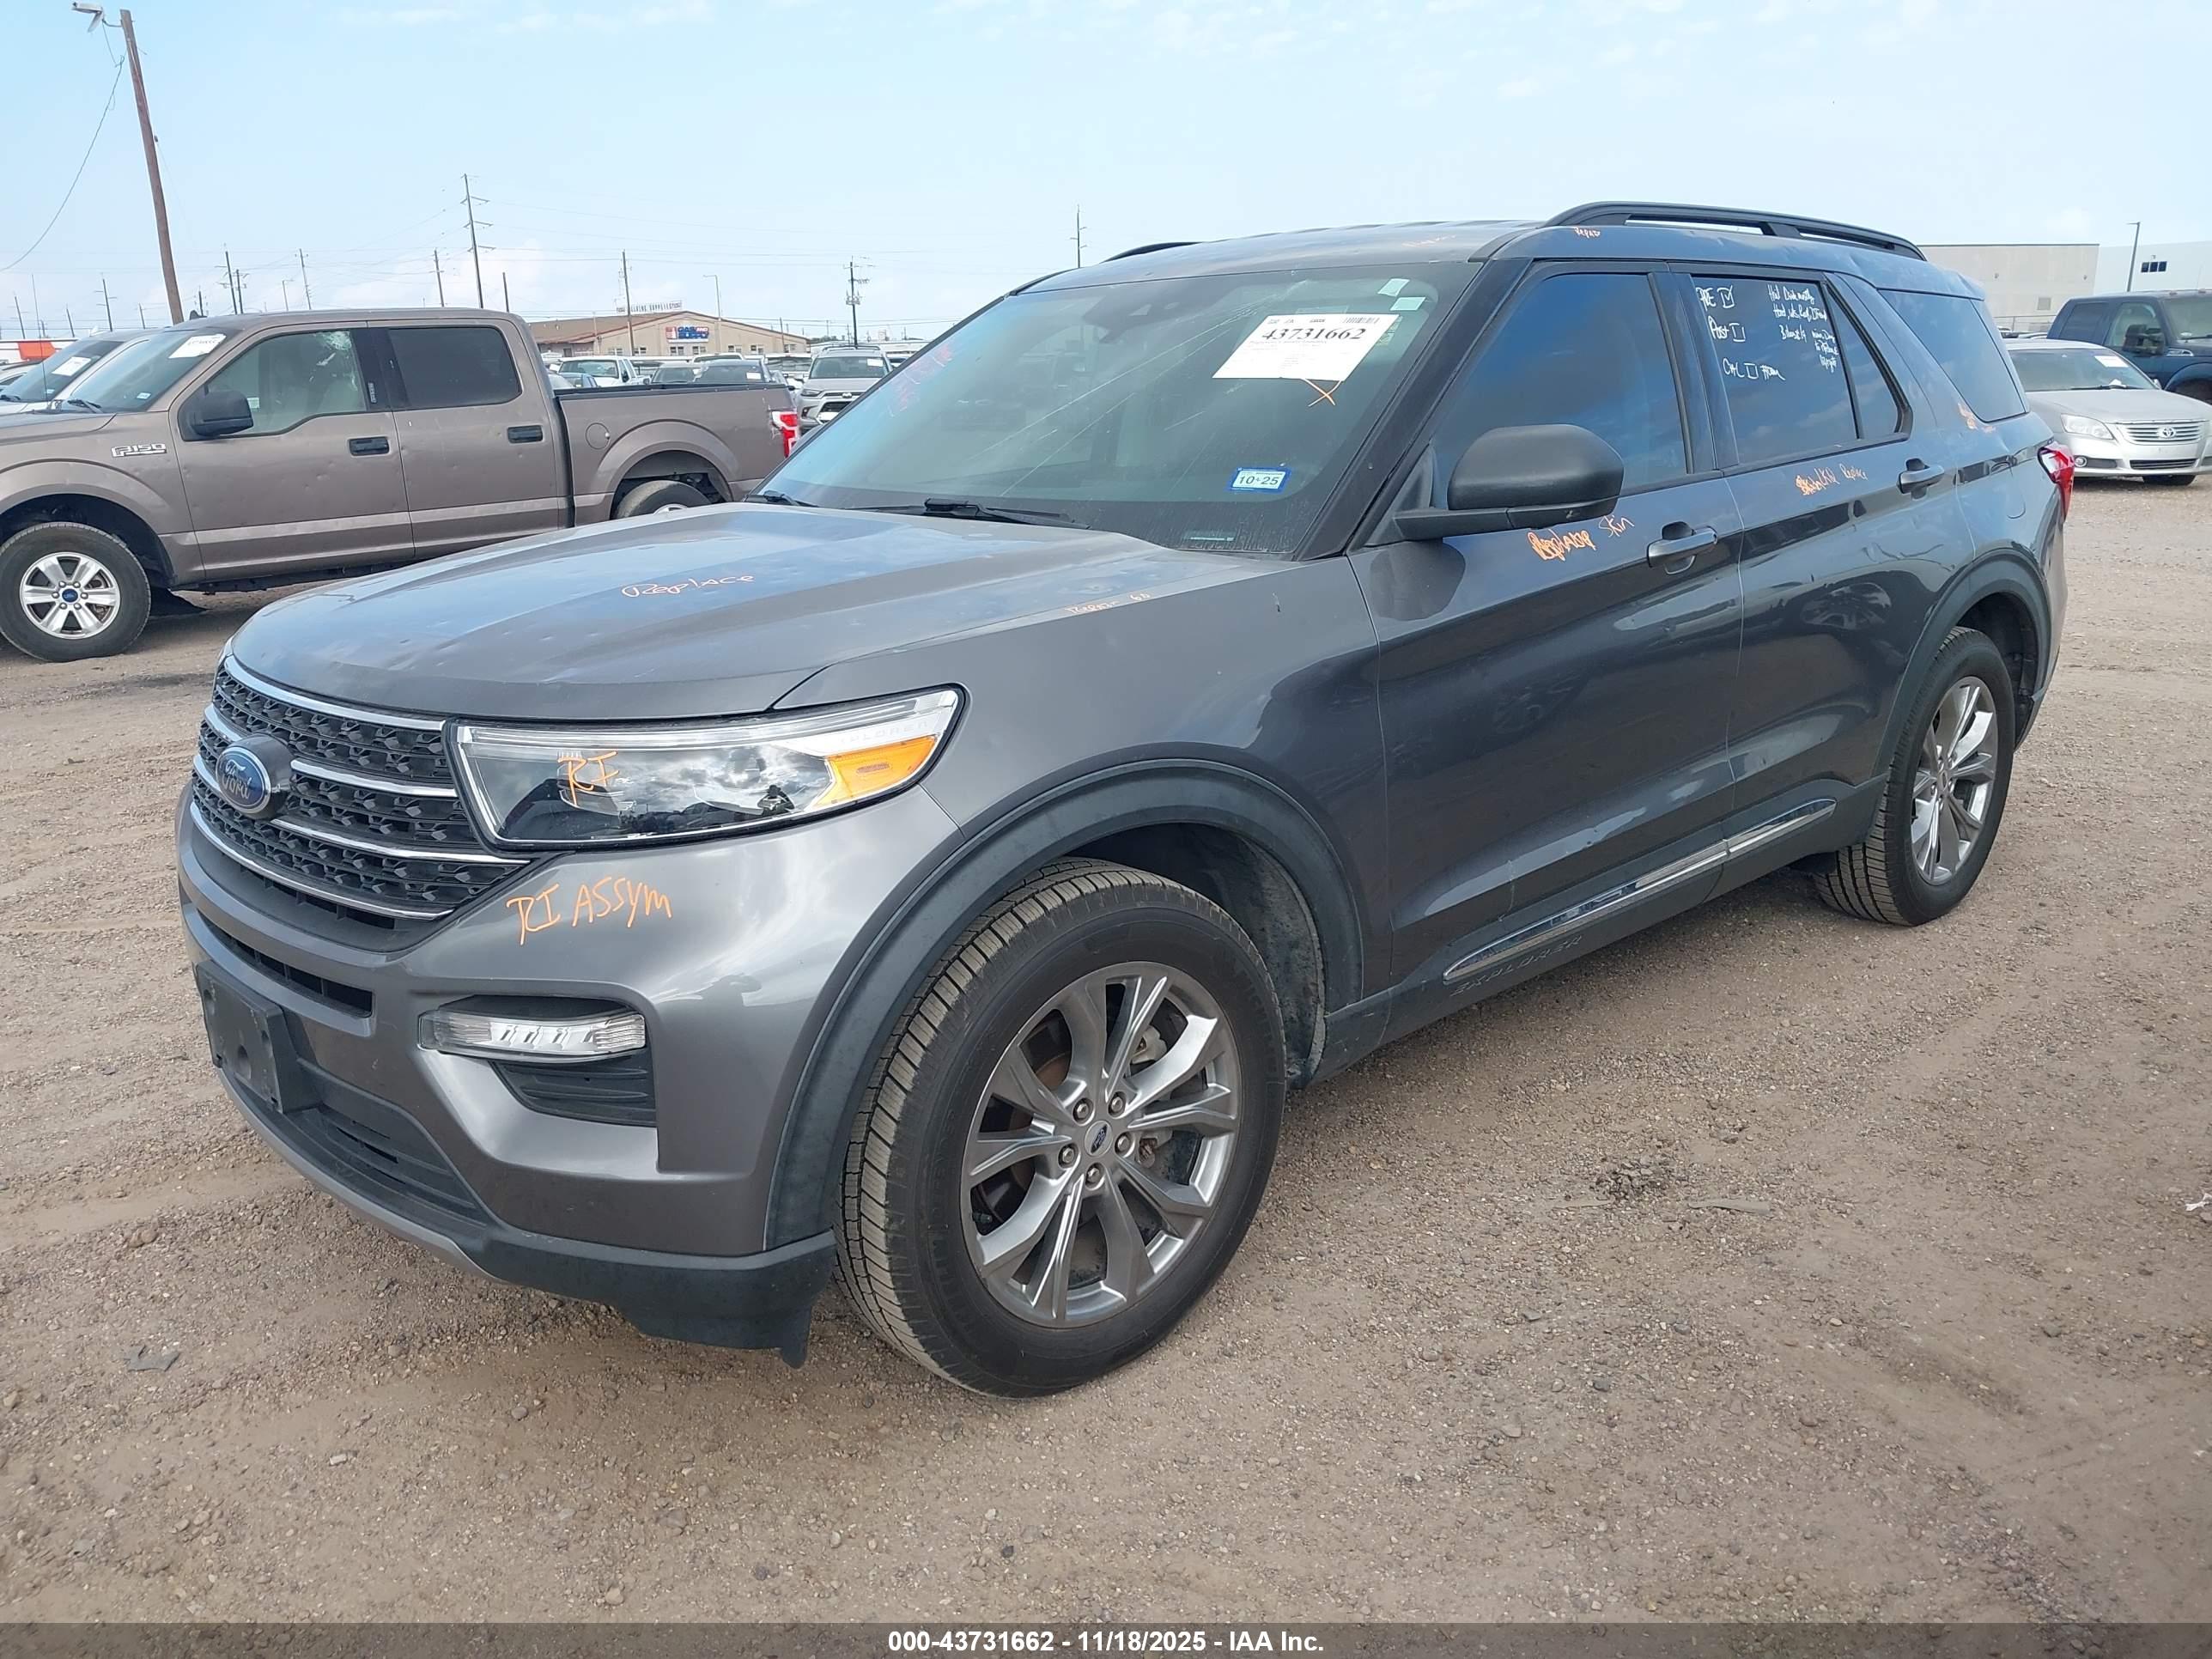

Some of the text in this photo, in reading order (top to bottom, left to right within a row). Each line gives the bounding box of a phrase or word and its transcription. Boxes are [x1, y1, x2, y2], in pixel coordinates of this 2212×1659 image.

[1261, 326, 1367, 341] 43731662
[1597, 514, 1635, 538] Skin
[621, 575, 757, 599] Replace
[222, 758, 252, 799] Ford
[505, 876, 673, 945] RI ASSYM
